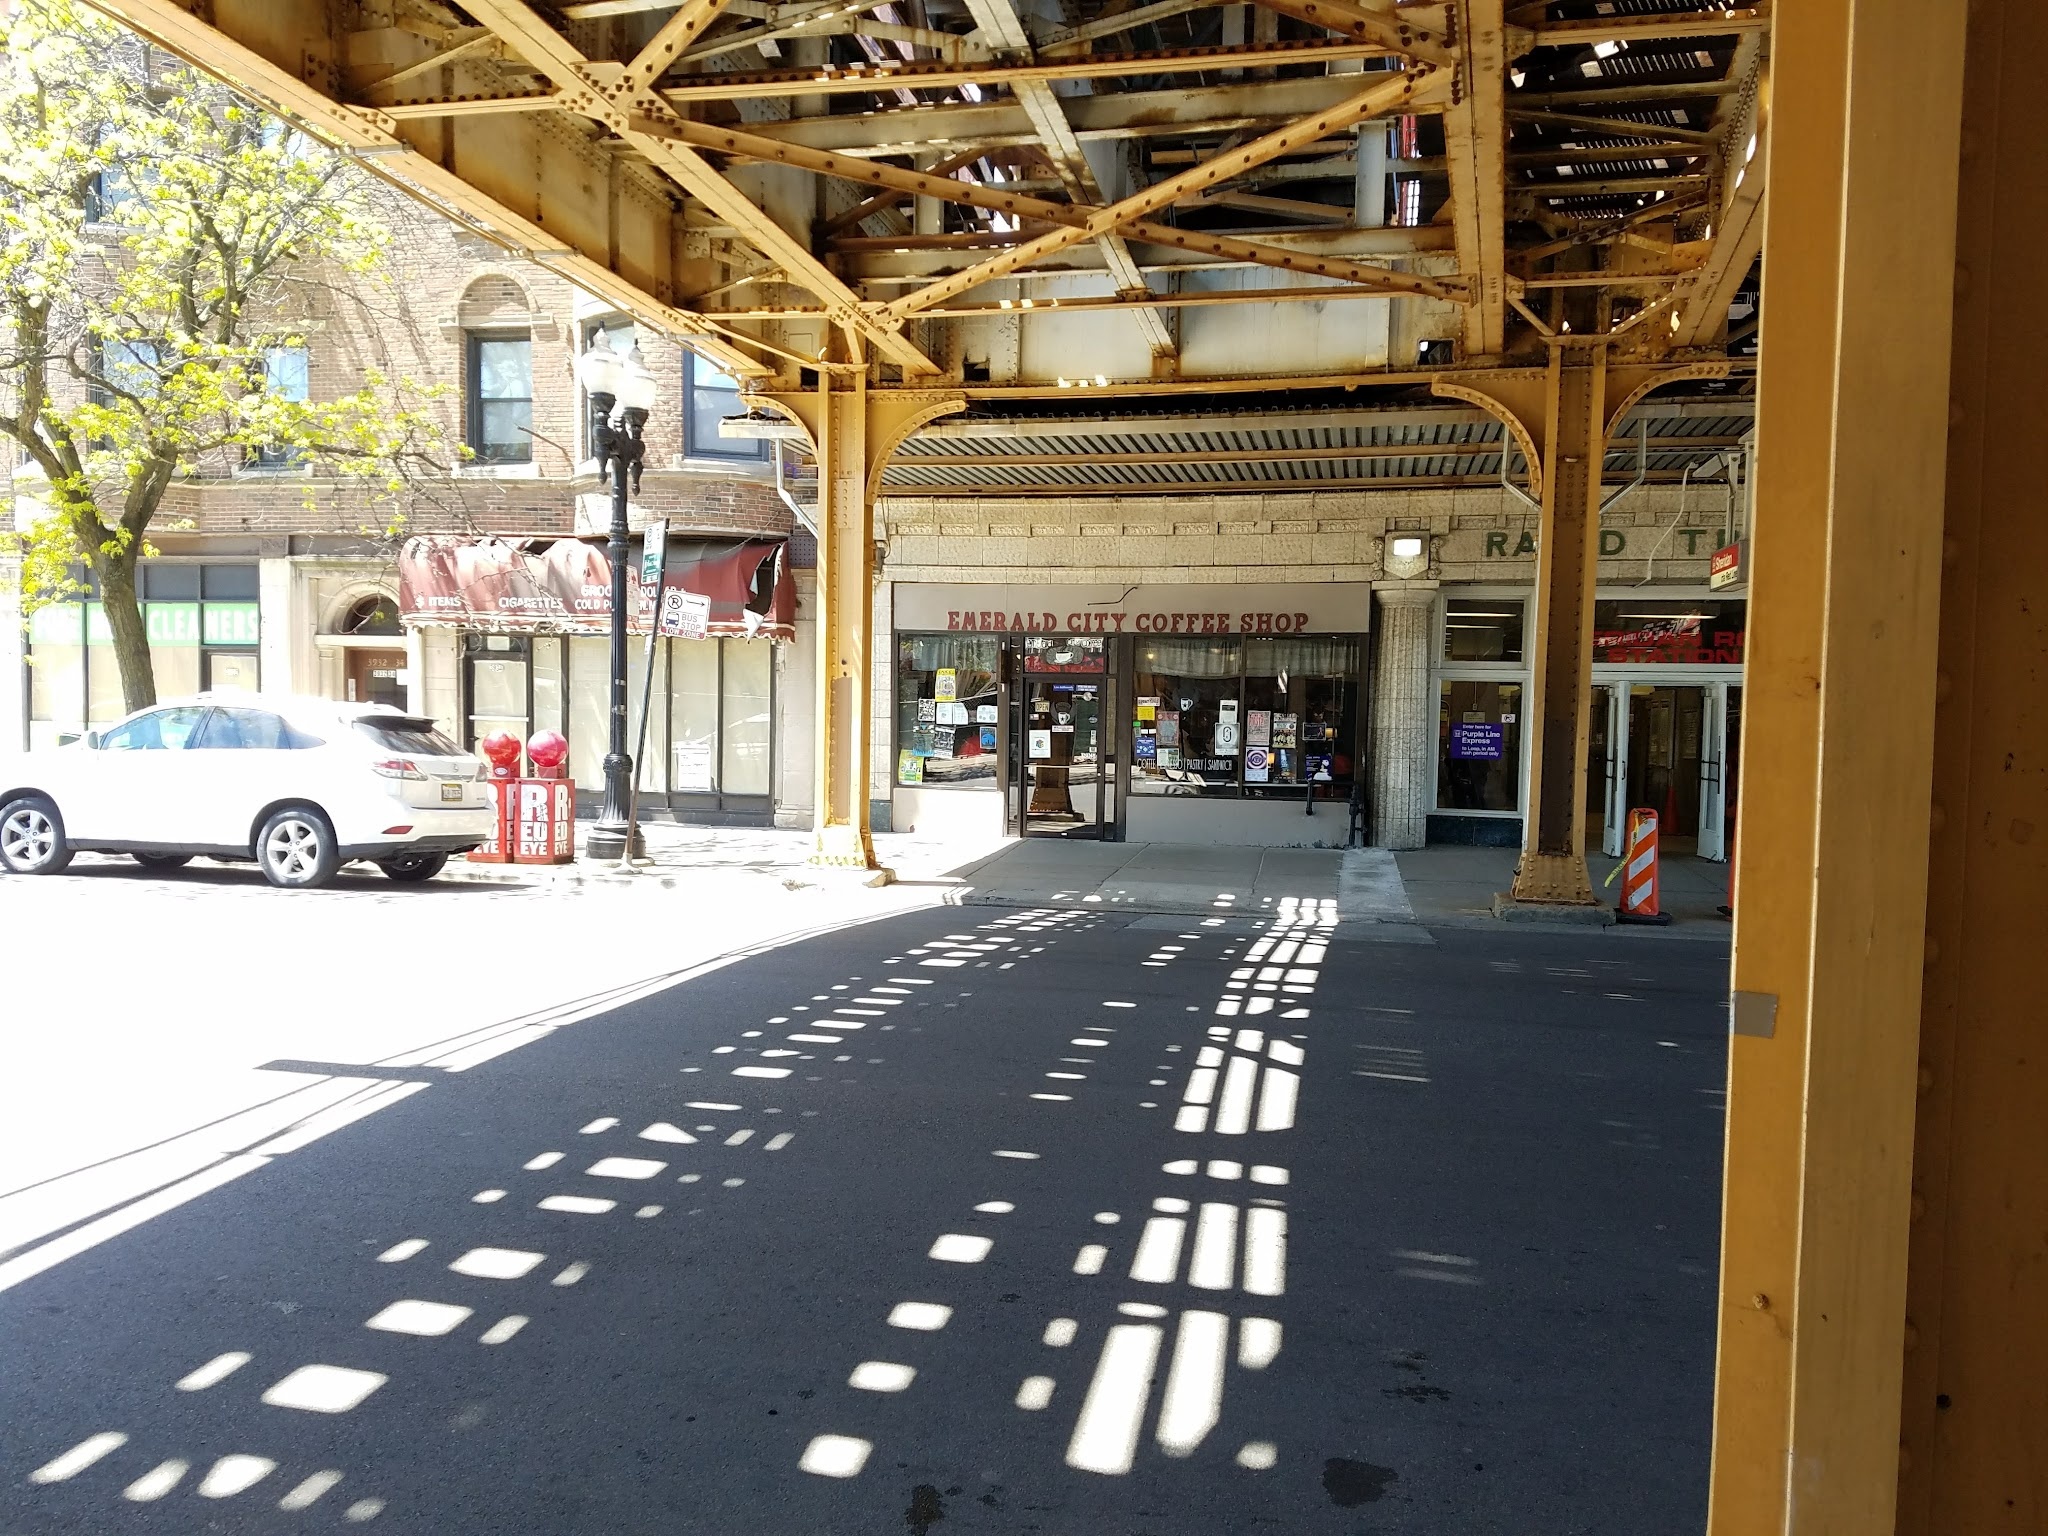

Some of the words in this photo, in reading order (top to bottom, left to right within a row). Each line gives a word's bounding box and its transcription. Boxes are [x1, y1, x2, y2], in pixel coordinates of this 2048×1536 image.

[1486, 529, 1626, 557] RAD
[428, 596, 461, 607] ITEMS
[498, 597, 563, 609] CIGARETTES
[574, 599, 600, 610] COLD
[682, 613, 698, 623] BUS
[948, 611, 1057, 631] EMERALD
[1067, 612, 1127, 632] CITY
[1135, 613, 1230, 632] COFFEE
[1240, 613, 1309, 632] SHOP
[149, 609, 258, 640] CLEANERS
[681, 621, 701, 631] STOP
[665, 627, 680, 635] TOW
[682, 628, 700, 638] ZONE
[1607, 650, 1739, 663] STATION
[1036, 701, 1049, 711] OPEN
[1186, 759, 1205, 771] PASTRY
[520, 841, 548, 856] EYE
[554, 841, 568, 856] EYE
